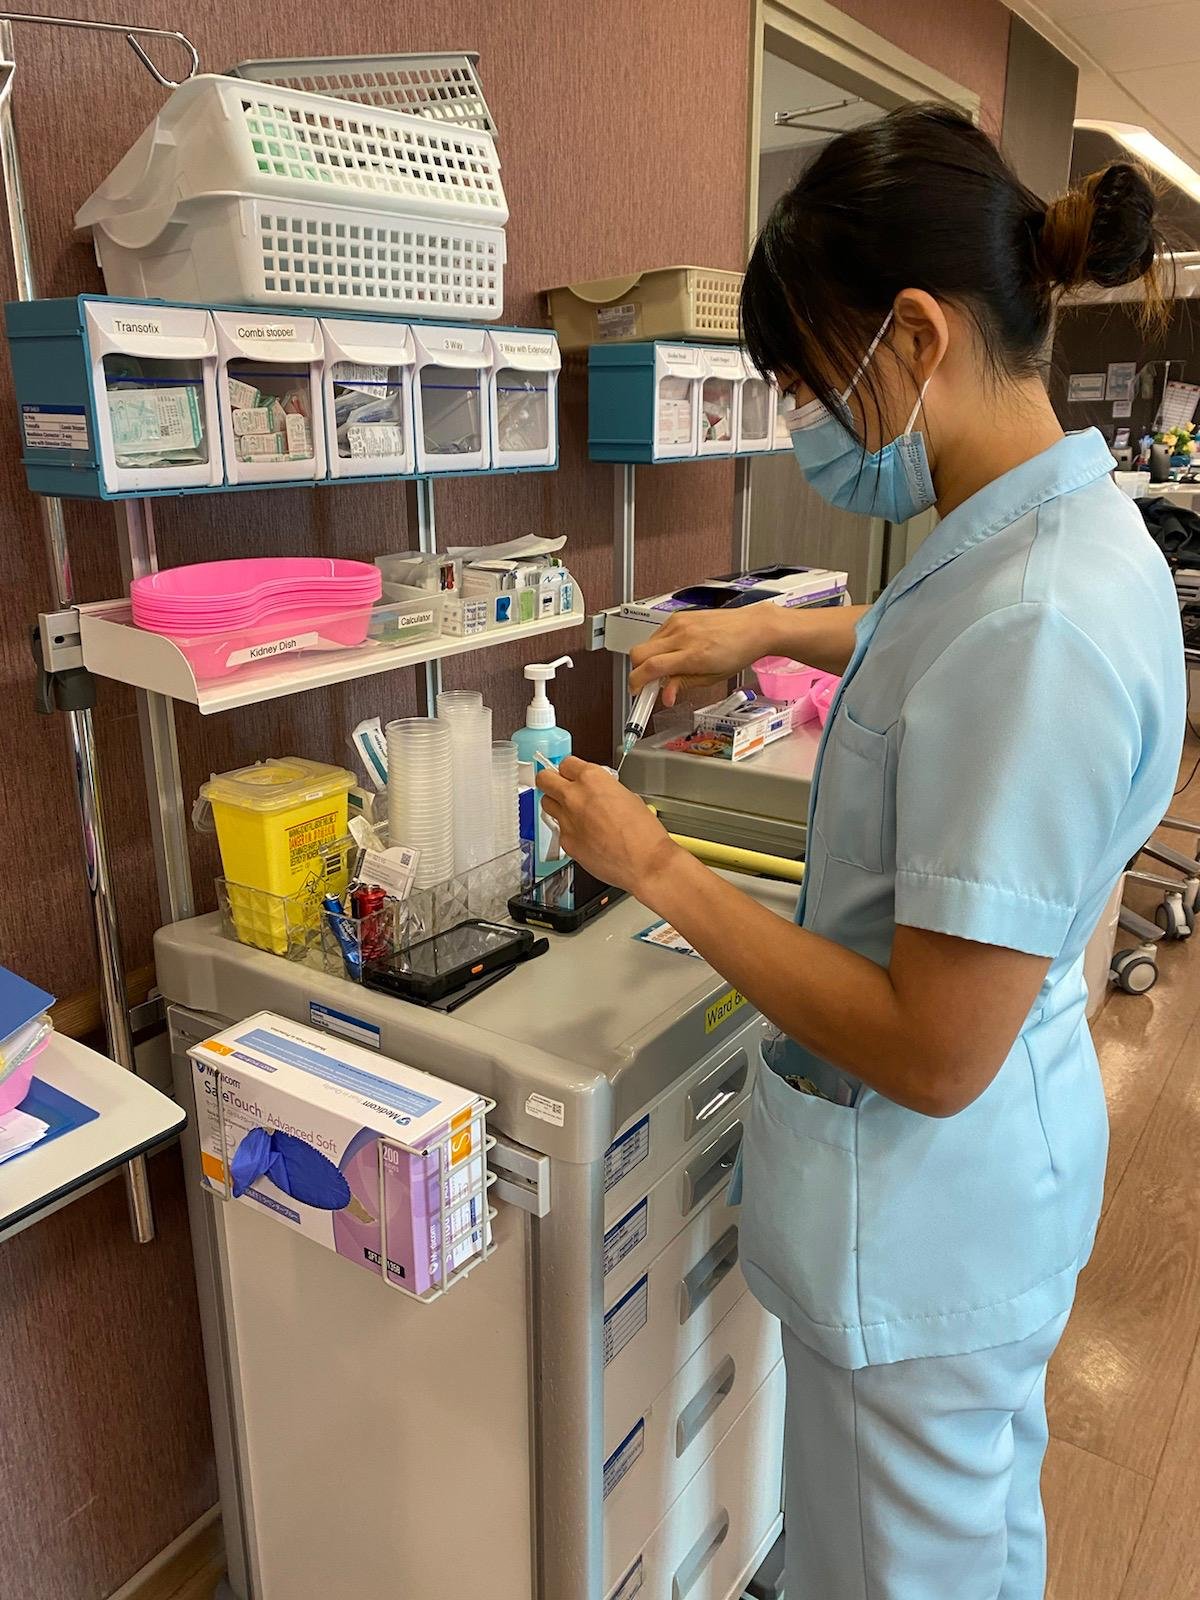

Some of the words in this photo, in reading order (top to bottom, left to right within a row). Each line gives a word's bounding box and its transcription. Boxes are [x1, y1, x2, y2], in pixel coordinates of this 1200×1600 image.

[115, 320, 160, 334] Transofix
[237, 327, 264, 338] Combi
[266, 328, 294, 338] stopper
[445, 340, 450, 349] 3
[450, 340, 463, 350] Way
[504, 343, 517, 353] Way
[517, 344, 527, 353] with
[528, 345, 551, 354] Extension
[400, 613, 431, 626] Calculator
[250, 642, 278, 658] Kidney
[279, 639, 297, 651] Dish
[707, 996, 732, 1026] Ward
[204, 1080, 262, 1118] SaeTouch
[267, 1113, 314, 1143] Advanced
[316, 1134, 337, 1153] Soft
[362, 1100, 401, 1120] Medicom
[453, 1132, 470, 1152] S
[383, 1145, 399, 1165] 200
